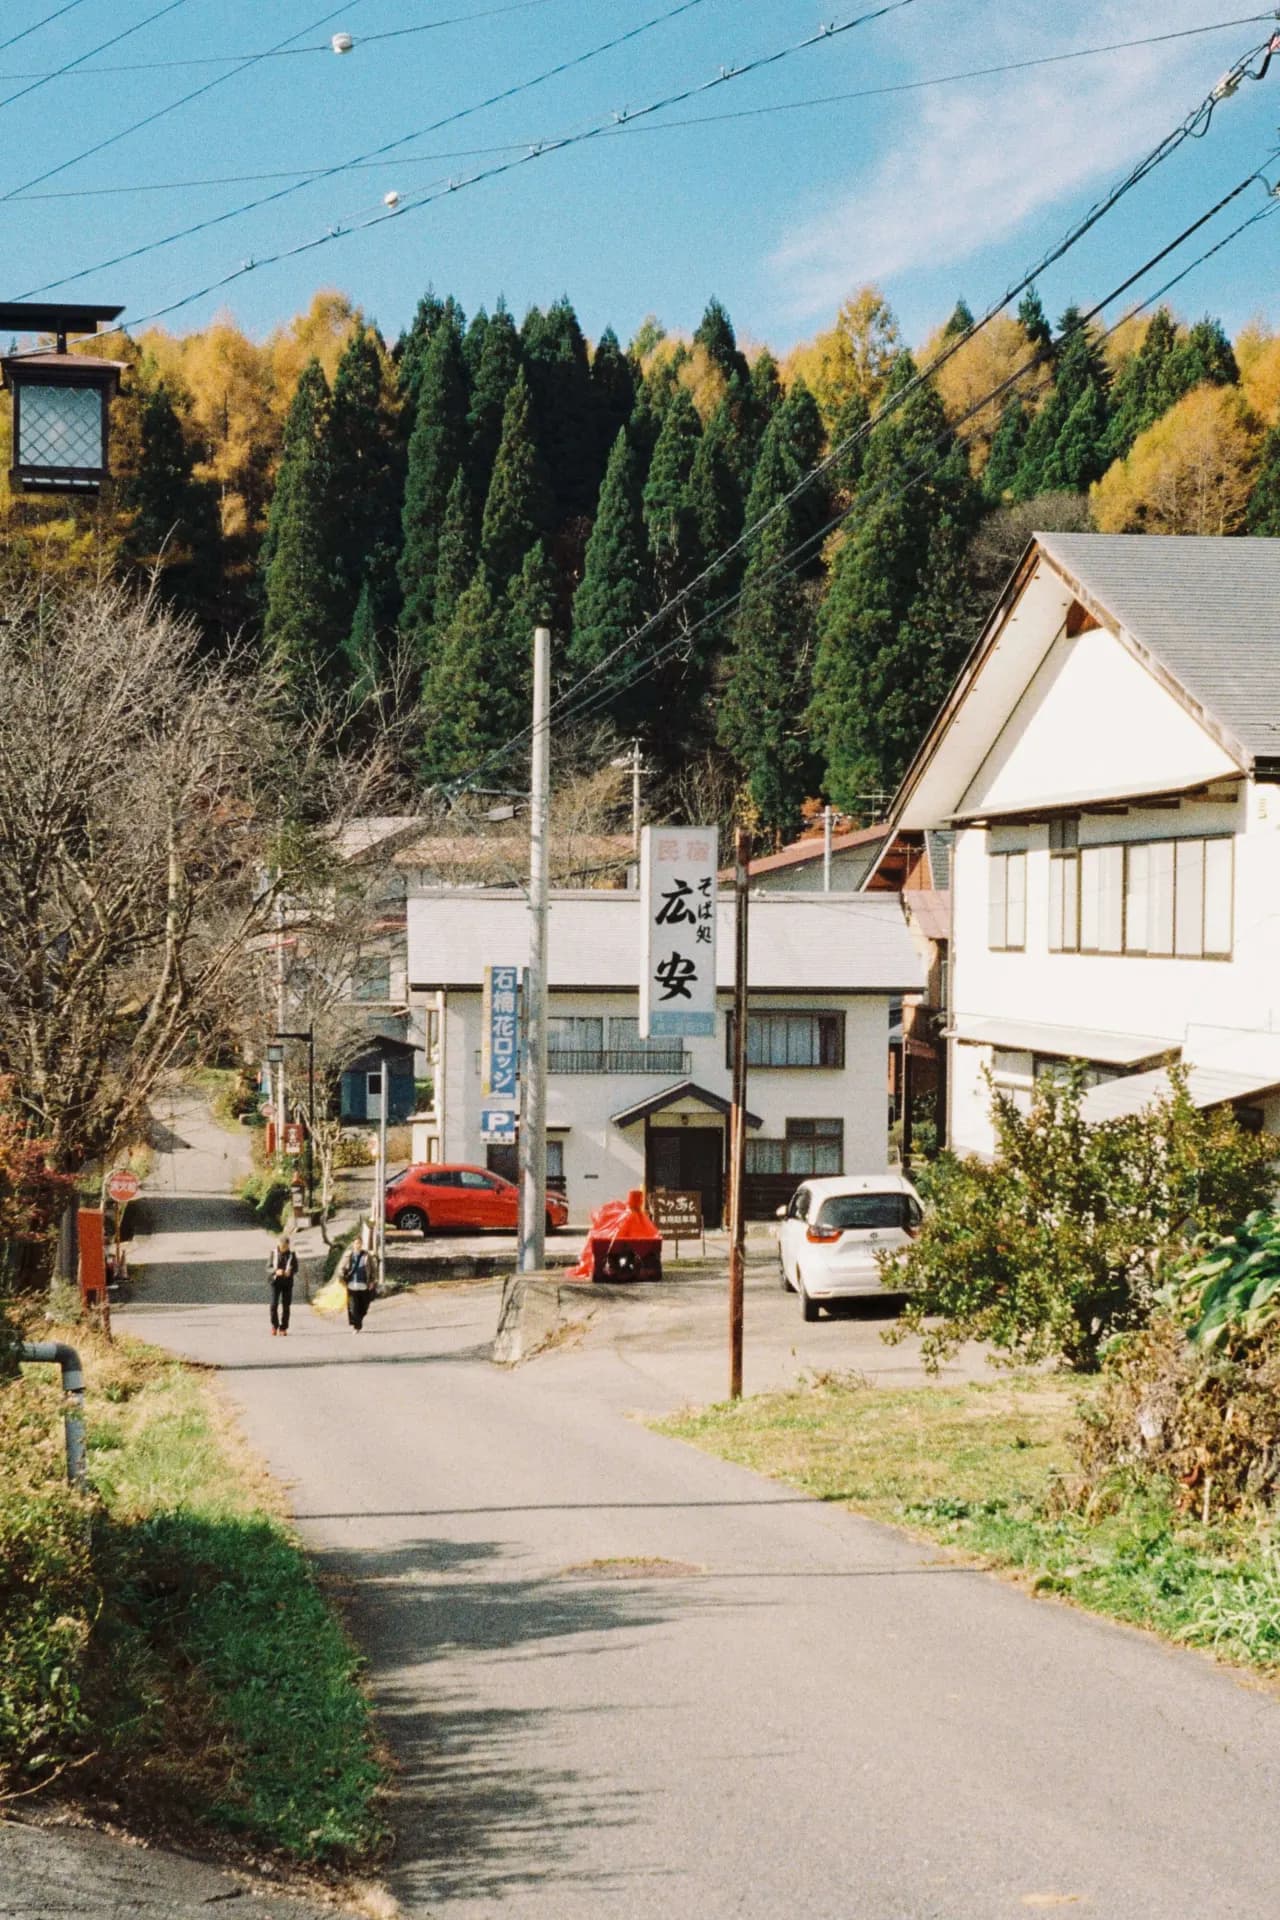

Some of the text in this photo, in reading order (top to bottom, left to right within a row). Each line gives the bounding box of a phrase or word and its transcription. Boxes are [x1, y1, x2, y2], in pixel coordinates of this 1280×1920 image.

[654, 878, 698, 1001] 広安
[696, 876, 713, 944] そば処
[488, 1113, 509, 1131] P
